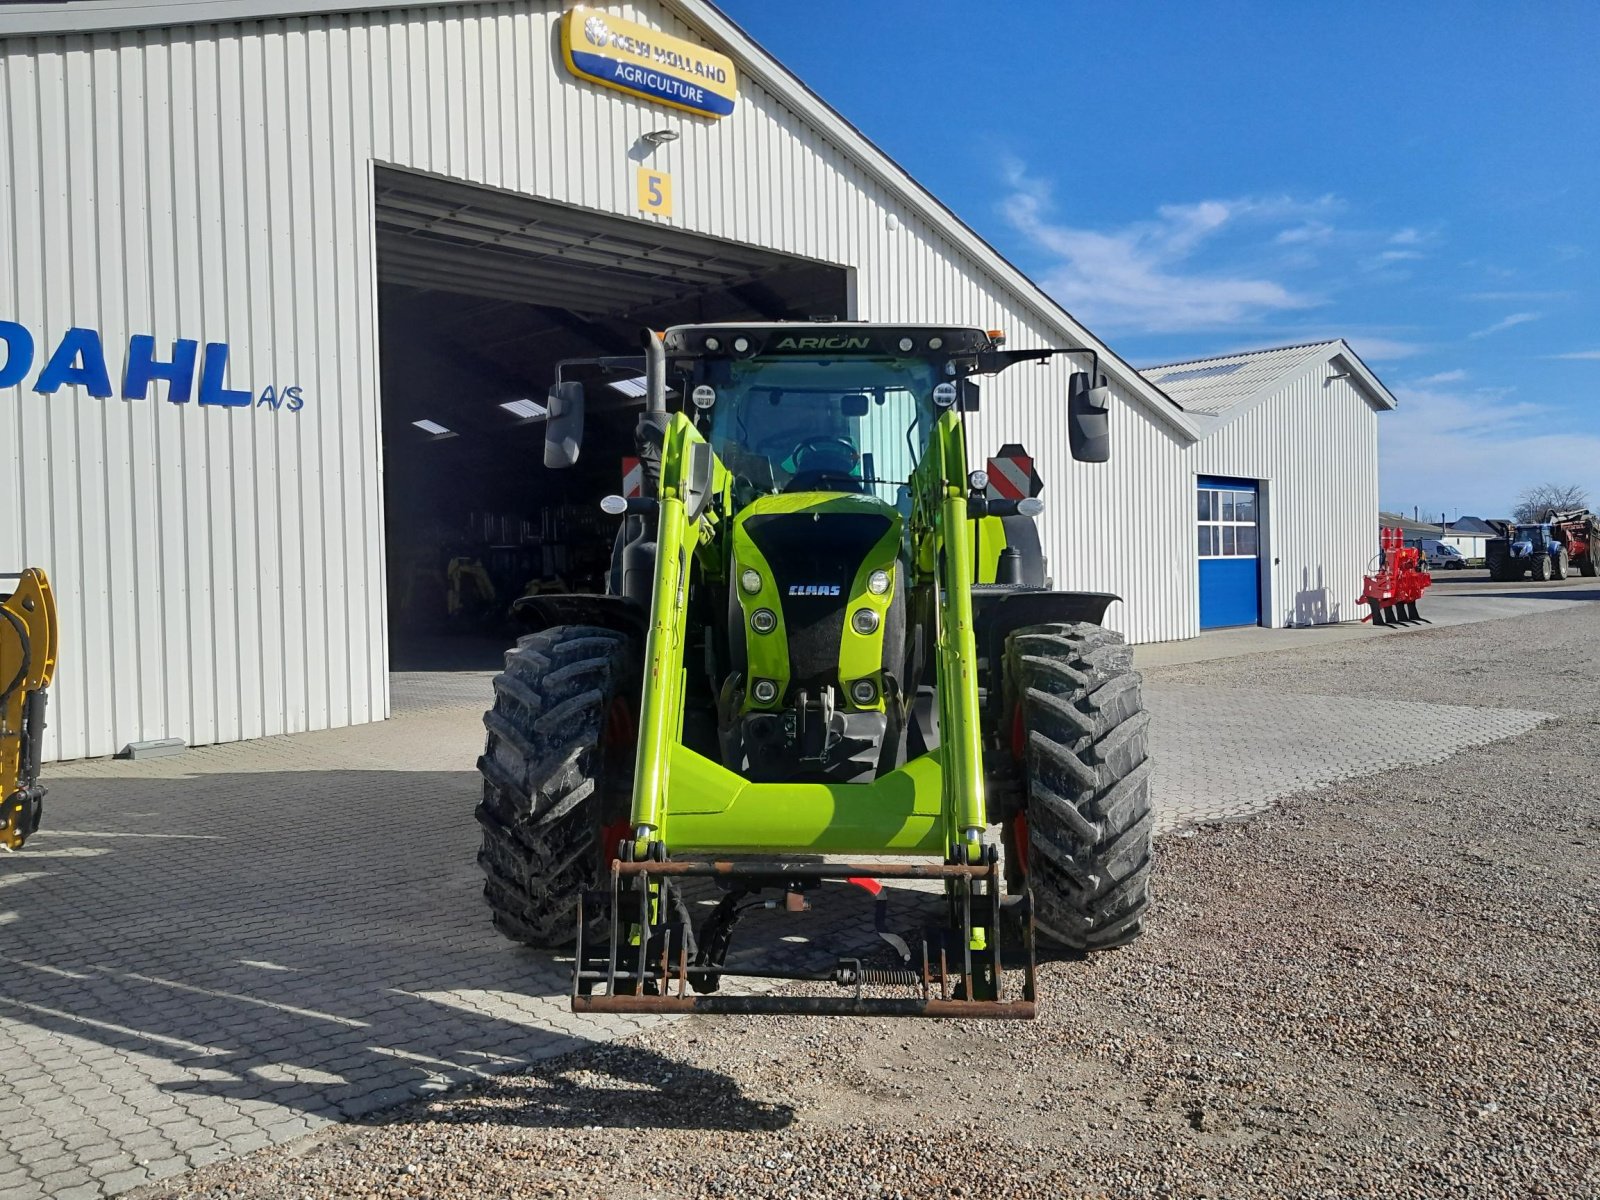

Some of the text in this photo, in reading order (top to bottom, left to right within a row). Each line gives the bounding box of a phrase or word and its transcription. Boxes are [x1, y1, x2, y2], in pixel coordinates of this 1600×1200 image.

[614, 64, 703, 104] AGRICULTURE
[647, 175, 663, 206] 5
[776, 337, 870, 349] ARION
[256, 384, 304, 412] A/S
[788, 585, 841, 596] CLAAS
